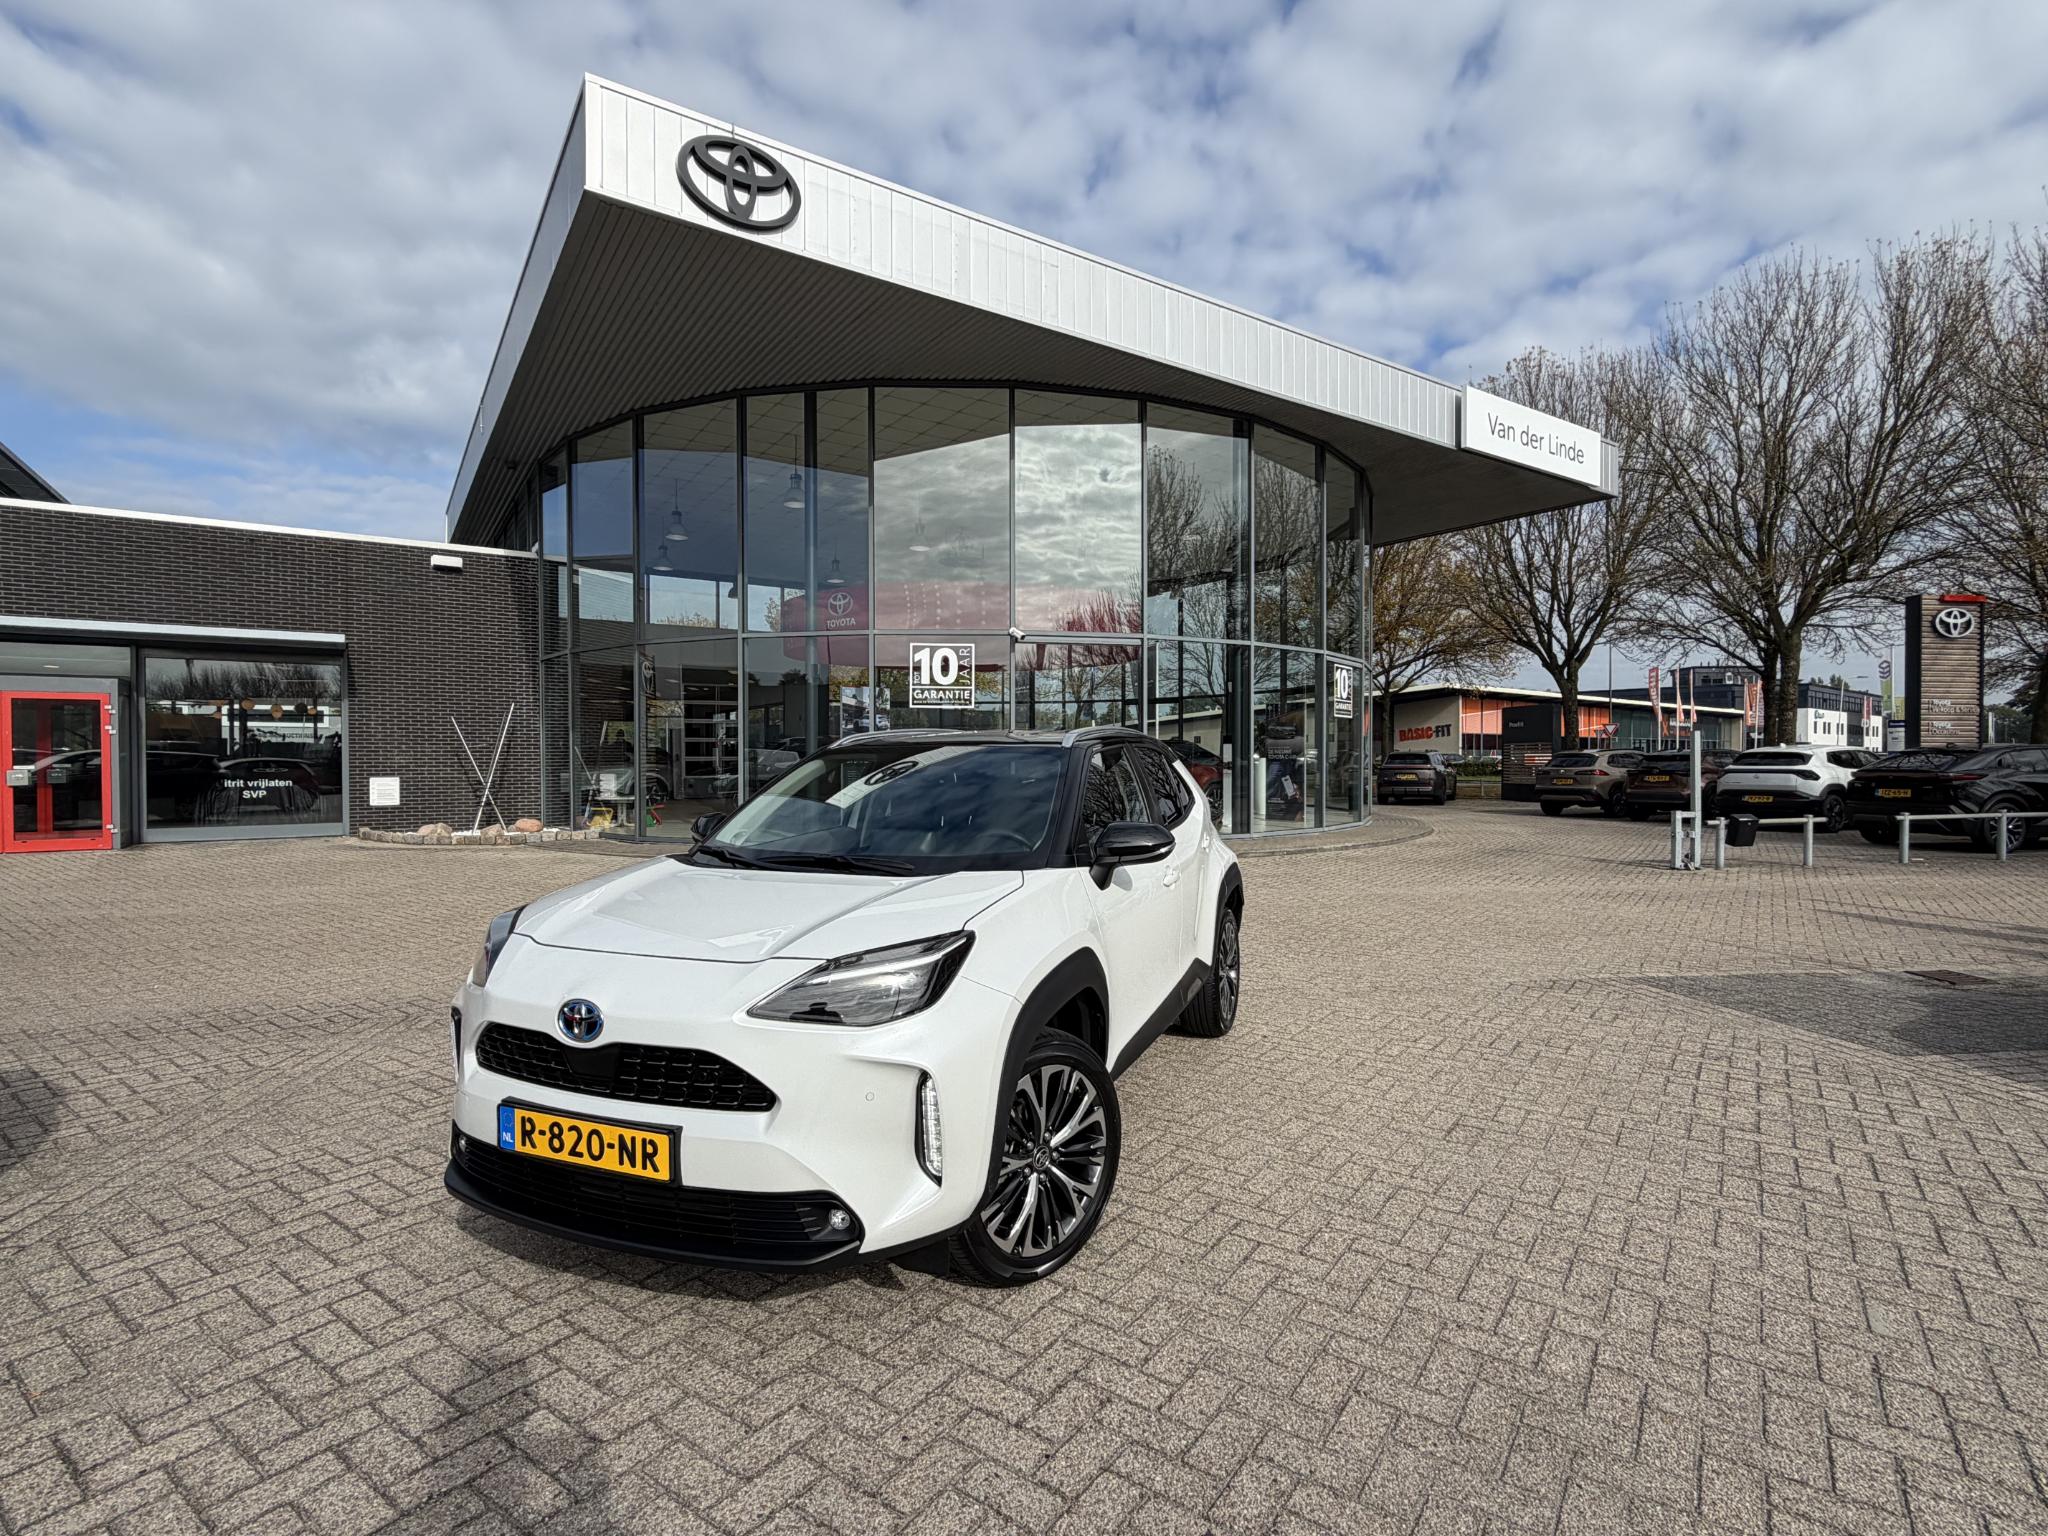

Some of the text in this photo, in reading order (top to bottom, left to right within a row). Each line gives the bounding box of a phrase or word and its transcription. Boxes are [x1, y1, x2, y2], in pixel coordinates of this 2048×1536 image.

[1487, 412, 1585, 464] Van der Linde
[826, 617, 856, 628] TOYOTA
[914, 647, 959, 685] 10
[959, 648, 970, 685] JAAR
[913, 690, 970, 699] GARANTIE
[1336, 668, 1349, 699] 10
[1399, 723, 1452, 742] BASIC-FIT
[222, 778, 293, 789] itrit vrijlaten
[242, 790, 267, 798] SVP
[503, 1115, 660, 1173] NL R-820-NR
